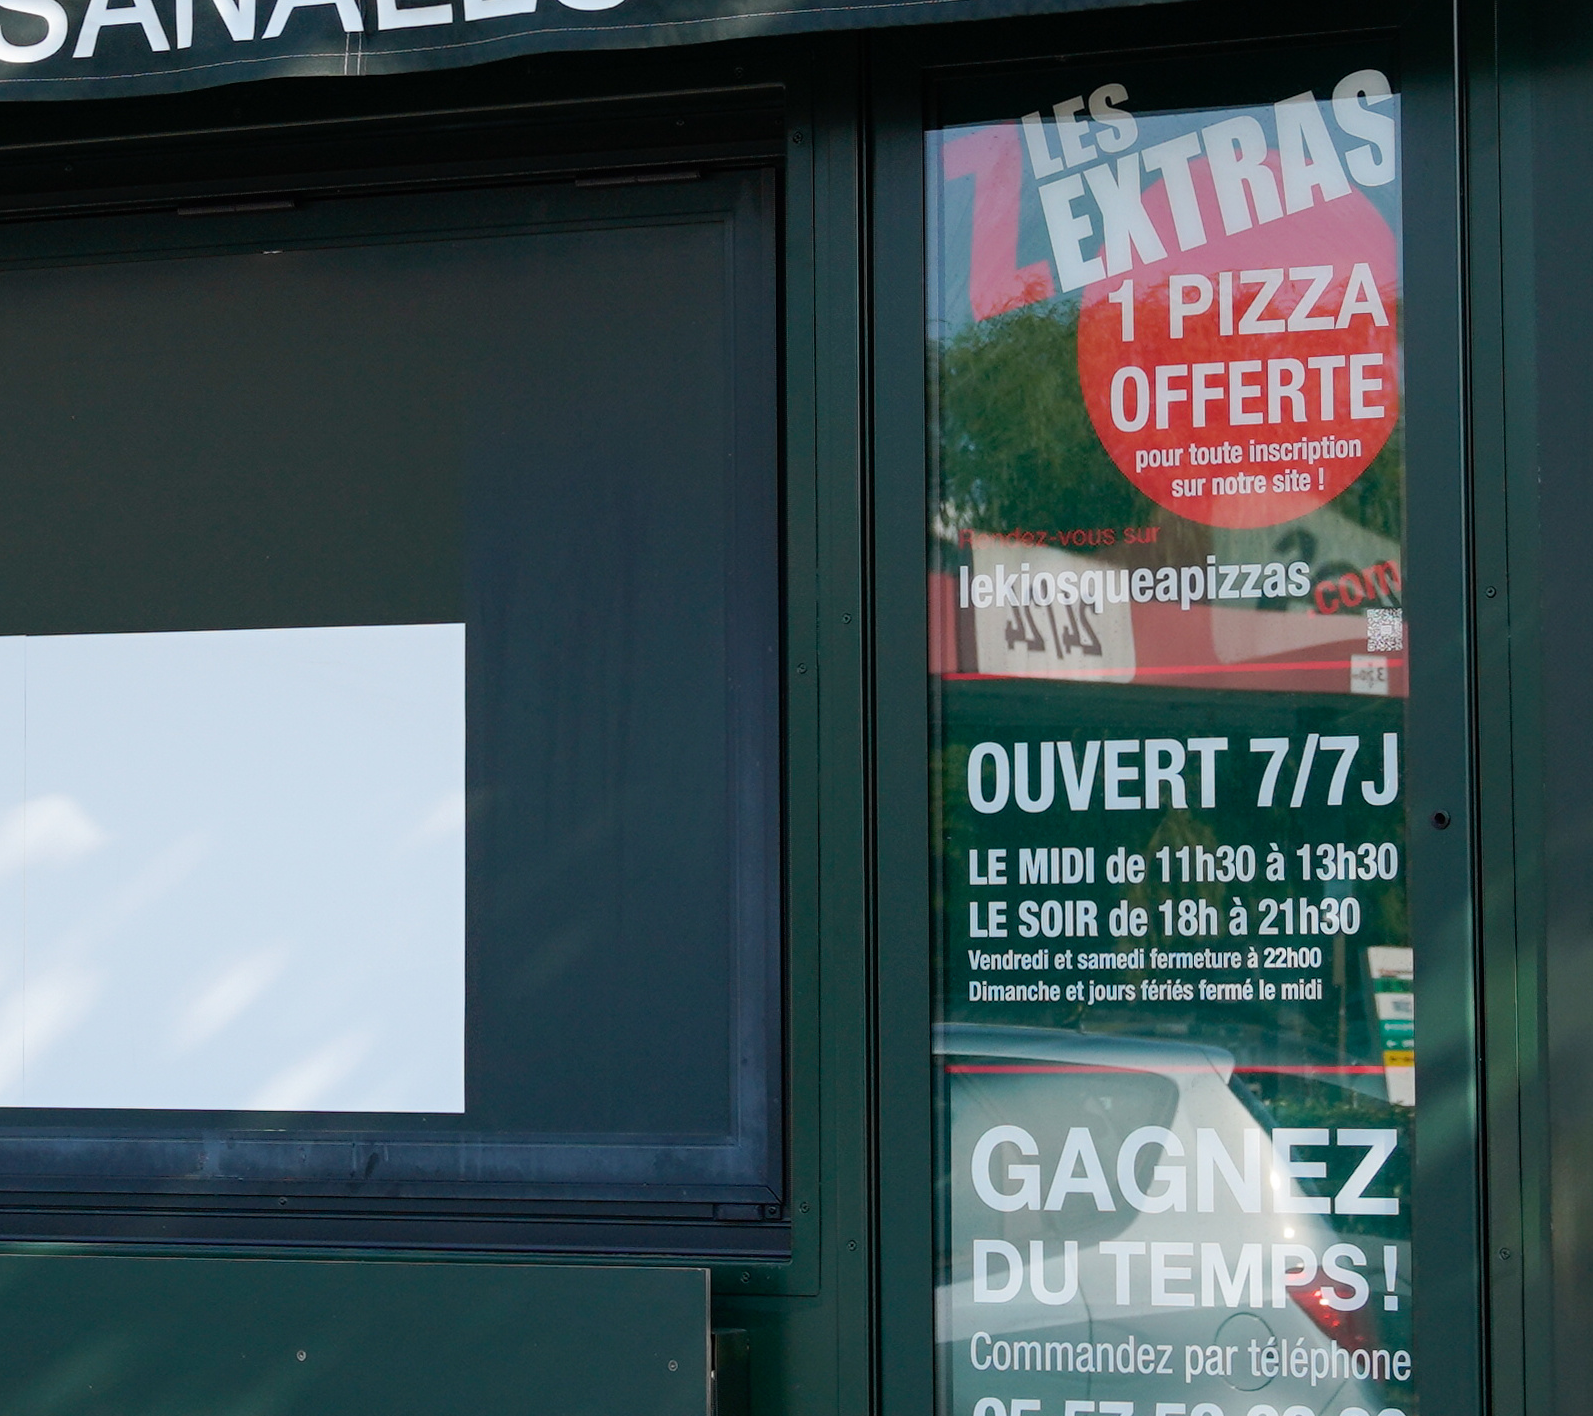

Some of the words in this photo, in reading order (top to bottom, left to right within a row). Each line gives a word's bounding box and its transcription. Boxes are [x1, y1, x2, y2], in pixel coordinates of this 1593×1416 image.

[1022, 83, 1139, 180] LES
[1038, 68, 1396, 294] EXTRAS
[1108, 279, 1135, 342] 1
[1169, 262, 1390, 340] PIZZA
[1110, 353, 1385, 434] OFFERTE
[1135, 443, 1182, 473] pour
[1189, 441, 1244, 466] toute
[1249, 436, 1362, 466] inscription
[1171, 473, 1207, 498] sur
[1211, 470, 1267, 496] notre
[1272, 467, 1311, 493] site
[958, 527, 1115, 550] Rendez-vous
[1123, 526, 1161, 544] sur
[959, 554, 1311, 613] lekiosqueapizzas
[967, 737, 1228, 814] OUVERT
[1250, 733, 1399, 809] 7/7J
[969, 849, 1007, 885] LE
[1019, 847, 1094, 884] MIDI
[1106, 847, 1146, 883] de
[1156, 844, 1256, 883] 11h30
[1266, 843, 1285, 882] à
[1297, 842, 1399, 882] 13h30
[969, 901, 1008, 938] LE
[1018, 899, 1098, 938] SOIR
[1109, 899, 1148, 938] de
[1158, 898, 1218, 937] 18h
[1229, 896, 1248, 936] à
[1259, 896, 1361, 936] 21h30
[968, 949, 1049, 971] Vendredi
[1054, 951, 1073, 970] et
[1077, 948, 1145, 970] samedi
[1150, 948, 1243, 969] fermeture
[1247, 946, 1259, 969] à
[1263, 947, 1323, 969] 22h00
[969, 981, 1061, 1003] Dimanche
[1065, 982, 1084, 1002] et
[1088, 981, 1137, 1006] jours
[1141, 979, 1194, 1002] fériés
[1198, 979, 1254, 1002] fermé
[1259, 980, 1276, 1001] le
[1281, 979, 1323, 1000] midi
[970, 1125, 1400, 1215] GAGNEZ
[972, 1239, 1078, 1306] DU
[970, 1331, 1174, 1375] Commandez
[1184, 1342, 1238, 1384] par
[1250, 1336, 1412, 1387] téléphone
